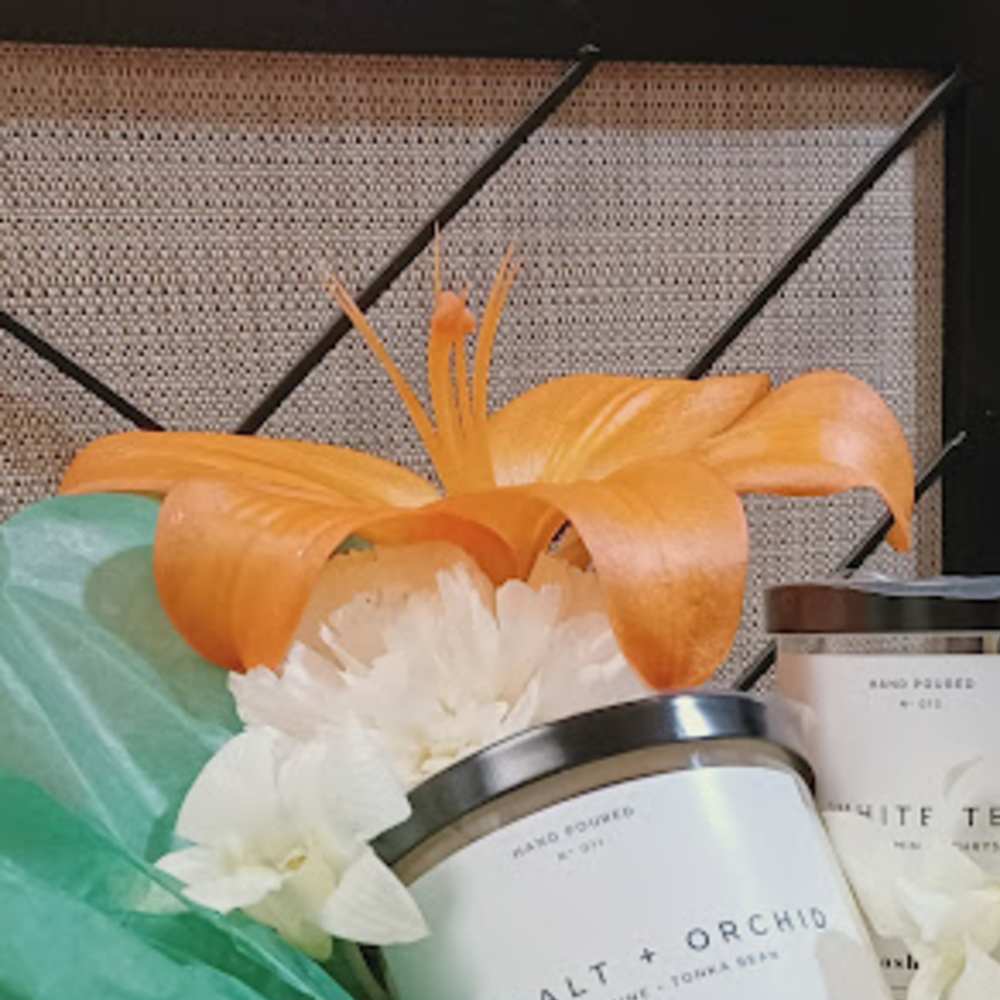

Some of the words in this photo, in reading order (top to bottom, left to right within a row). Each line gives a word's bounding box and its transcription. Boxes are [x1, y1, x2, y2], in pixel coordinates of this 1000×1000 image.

[639, 948, 656, 965] +
[685, 907, 828, 952] ORCHID
[669, 960, 731, 989] TONKA
